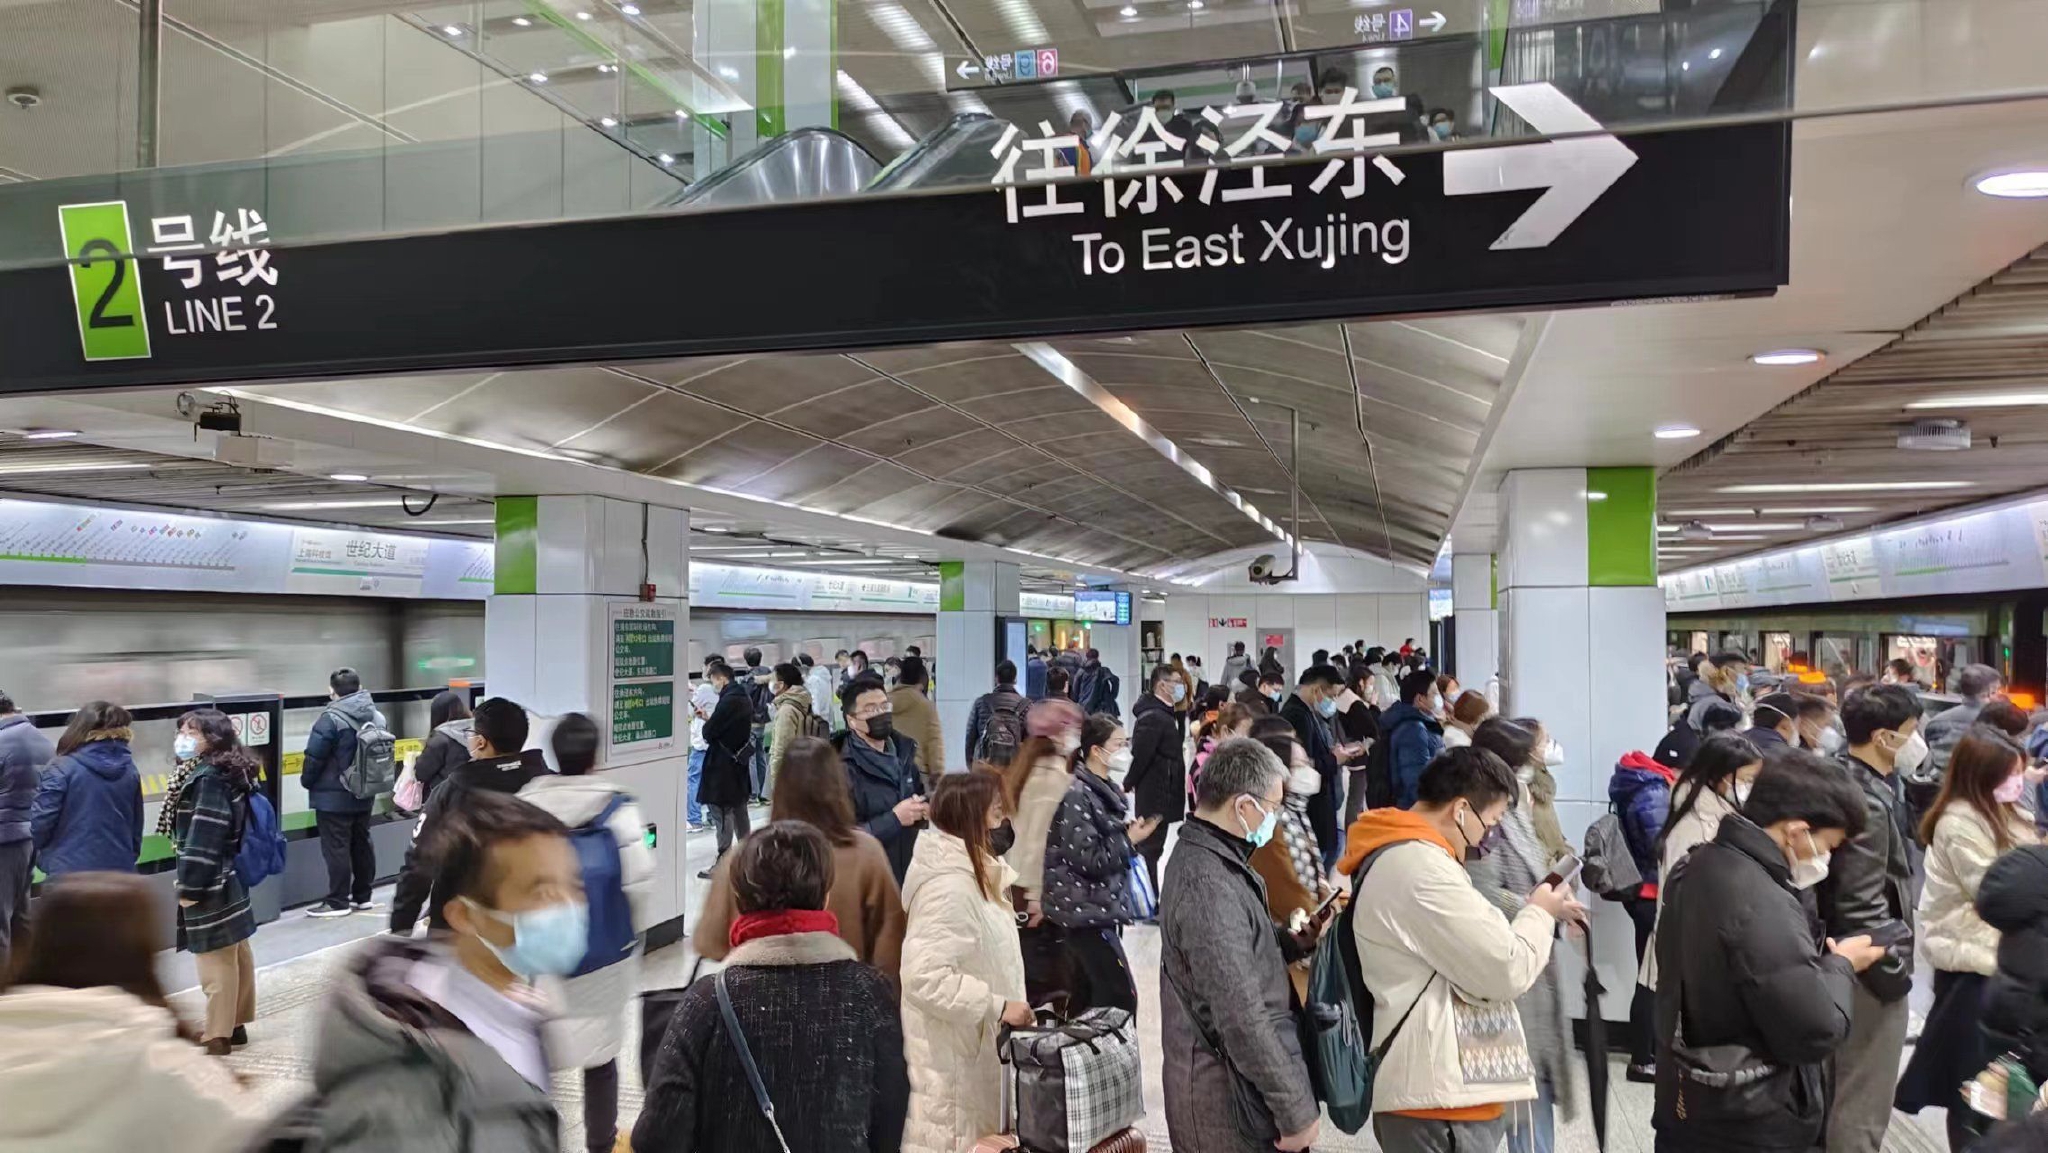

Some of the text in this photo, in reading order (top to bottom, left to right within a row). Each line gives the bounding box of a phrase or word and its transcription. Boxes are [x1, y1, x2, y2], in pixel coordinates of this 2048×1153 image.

[991, 86, 1406, 223] 往徐泾东
[78, 207, 279, 329] 2 号线
[1072, 212, 1411, 276] To East Xujing
[164, 294, 279, 335] LINE 2
[345, 540, 397, 561] 世纪大道
